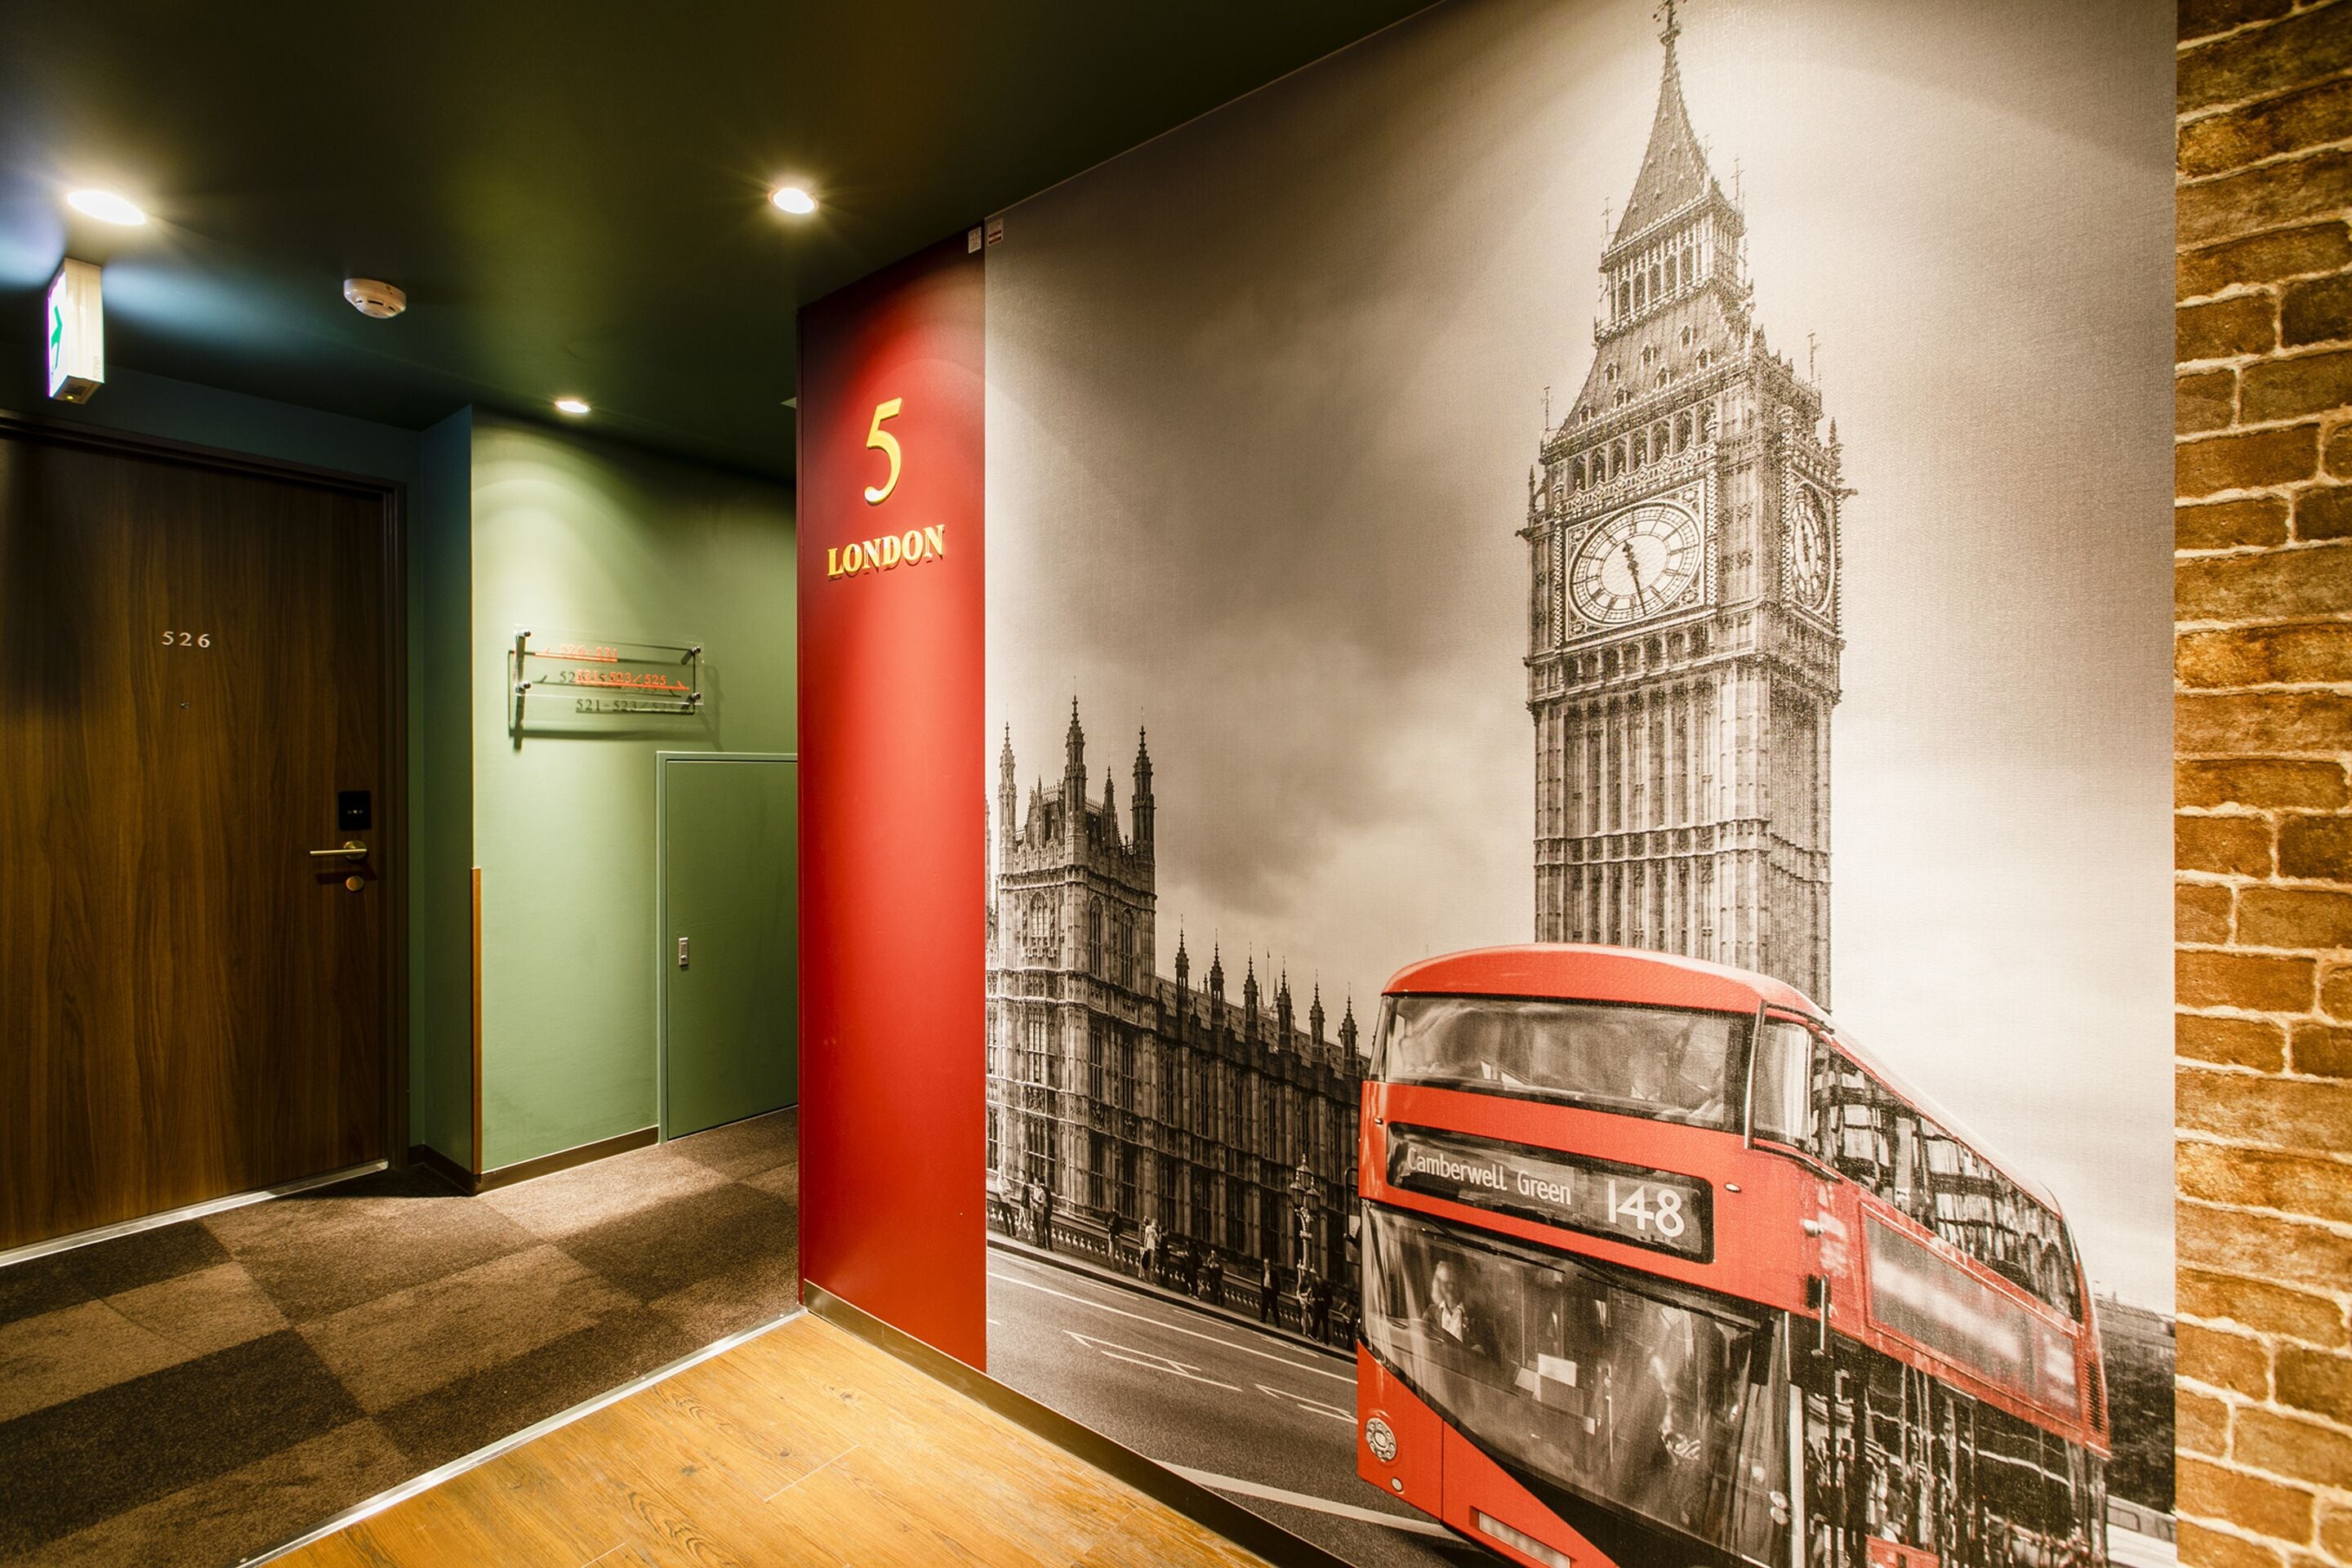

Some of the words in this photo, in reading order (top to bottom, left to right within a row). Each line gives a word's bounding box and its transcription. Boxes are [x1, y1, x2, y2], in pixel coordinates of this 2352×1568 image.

[864, 397, 902, 505] 5
[827, 523, 945, 577] LONDON
[162, 630, 211, 648] 526
[1407, 1147, 1508, 1192] Camberwell
[1517, 1169, 1572, 1205] Green
[1607, 1179, 1686, 1238] 148
